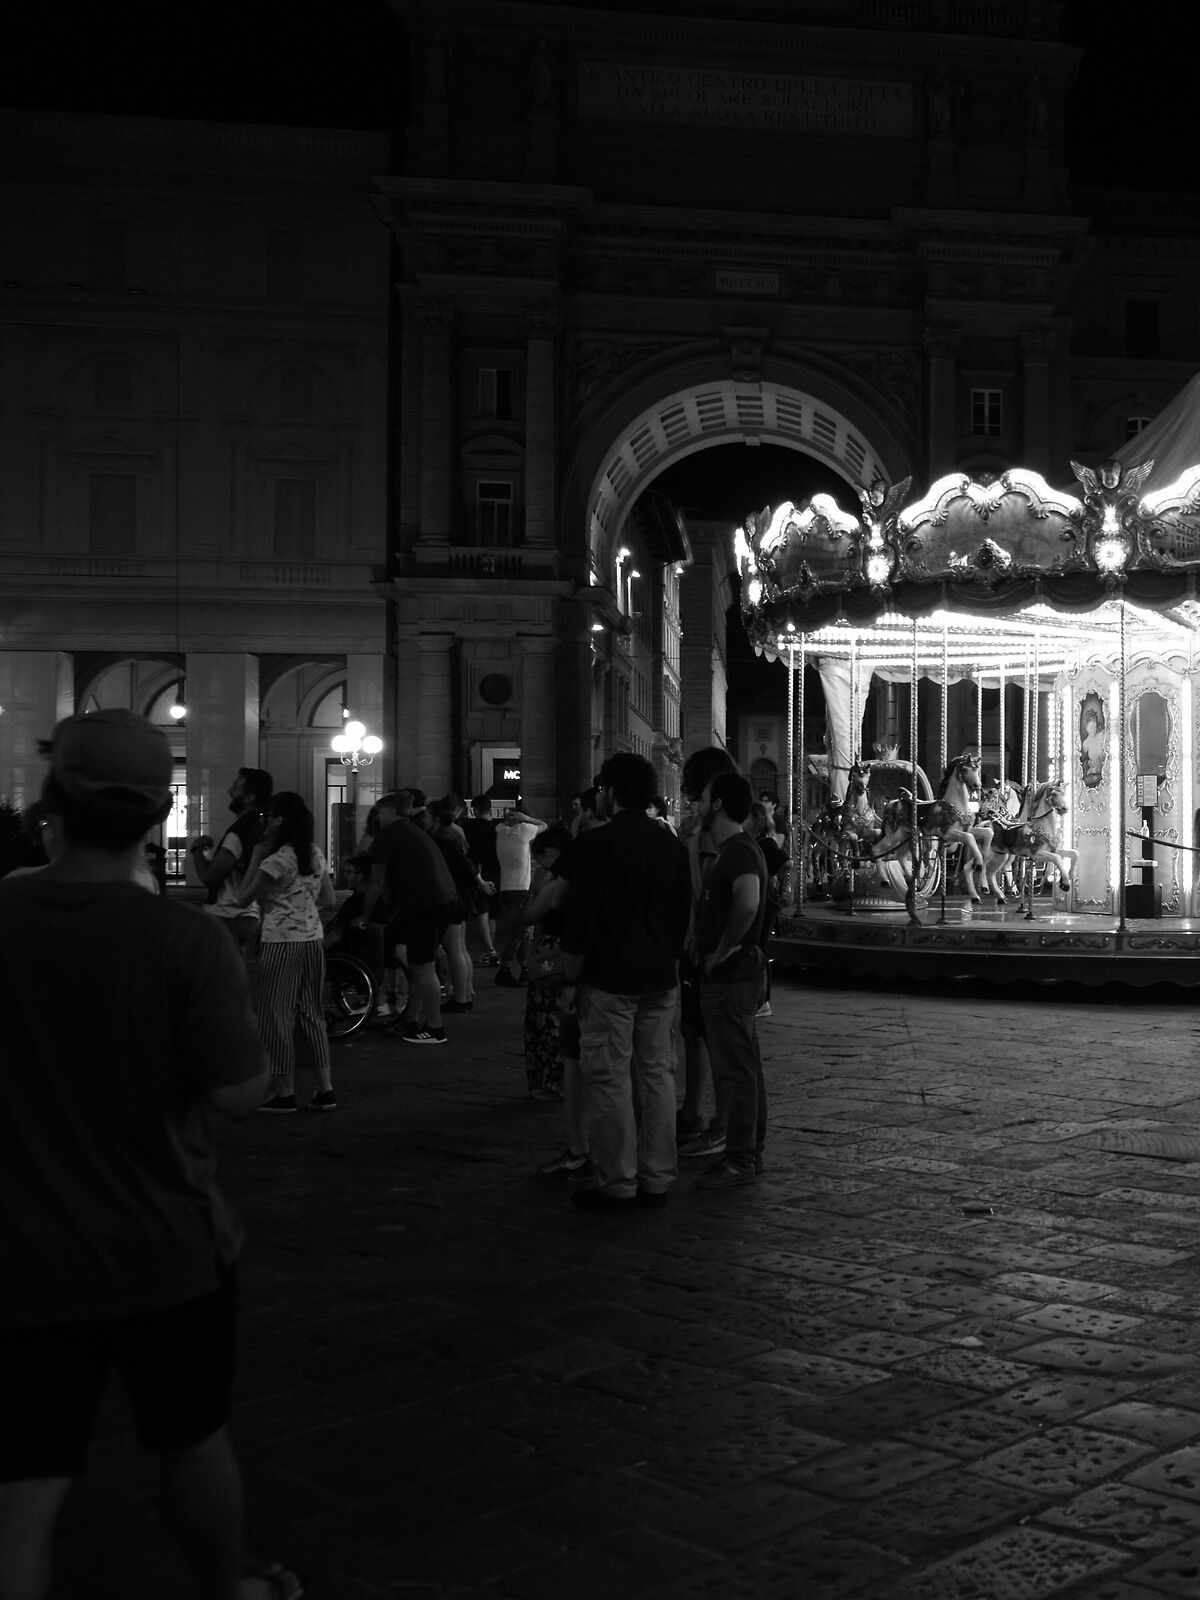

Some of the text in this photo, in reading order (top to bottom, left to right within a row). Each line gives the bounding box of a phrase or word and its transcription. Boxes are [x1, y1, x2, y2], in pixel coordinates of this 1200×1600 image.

[689, 72, 767, 91] CENTRO
[776, 79, 840, 96] DELLA
[617, 85, 877, 114] DA SECOLARE SQUALLORE
[637, 102, 681, 118] VITA
[690, 104, 755, 121] NUOVA
